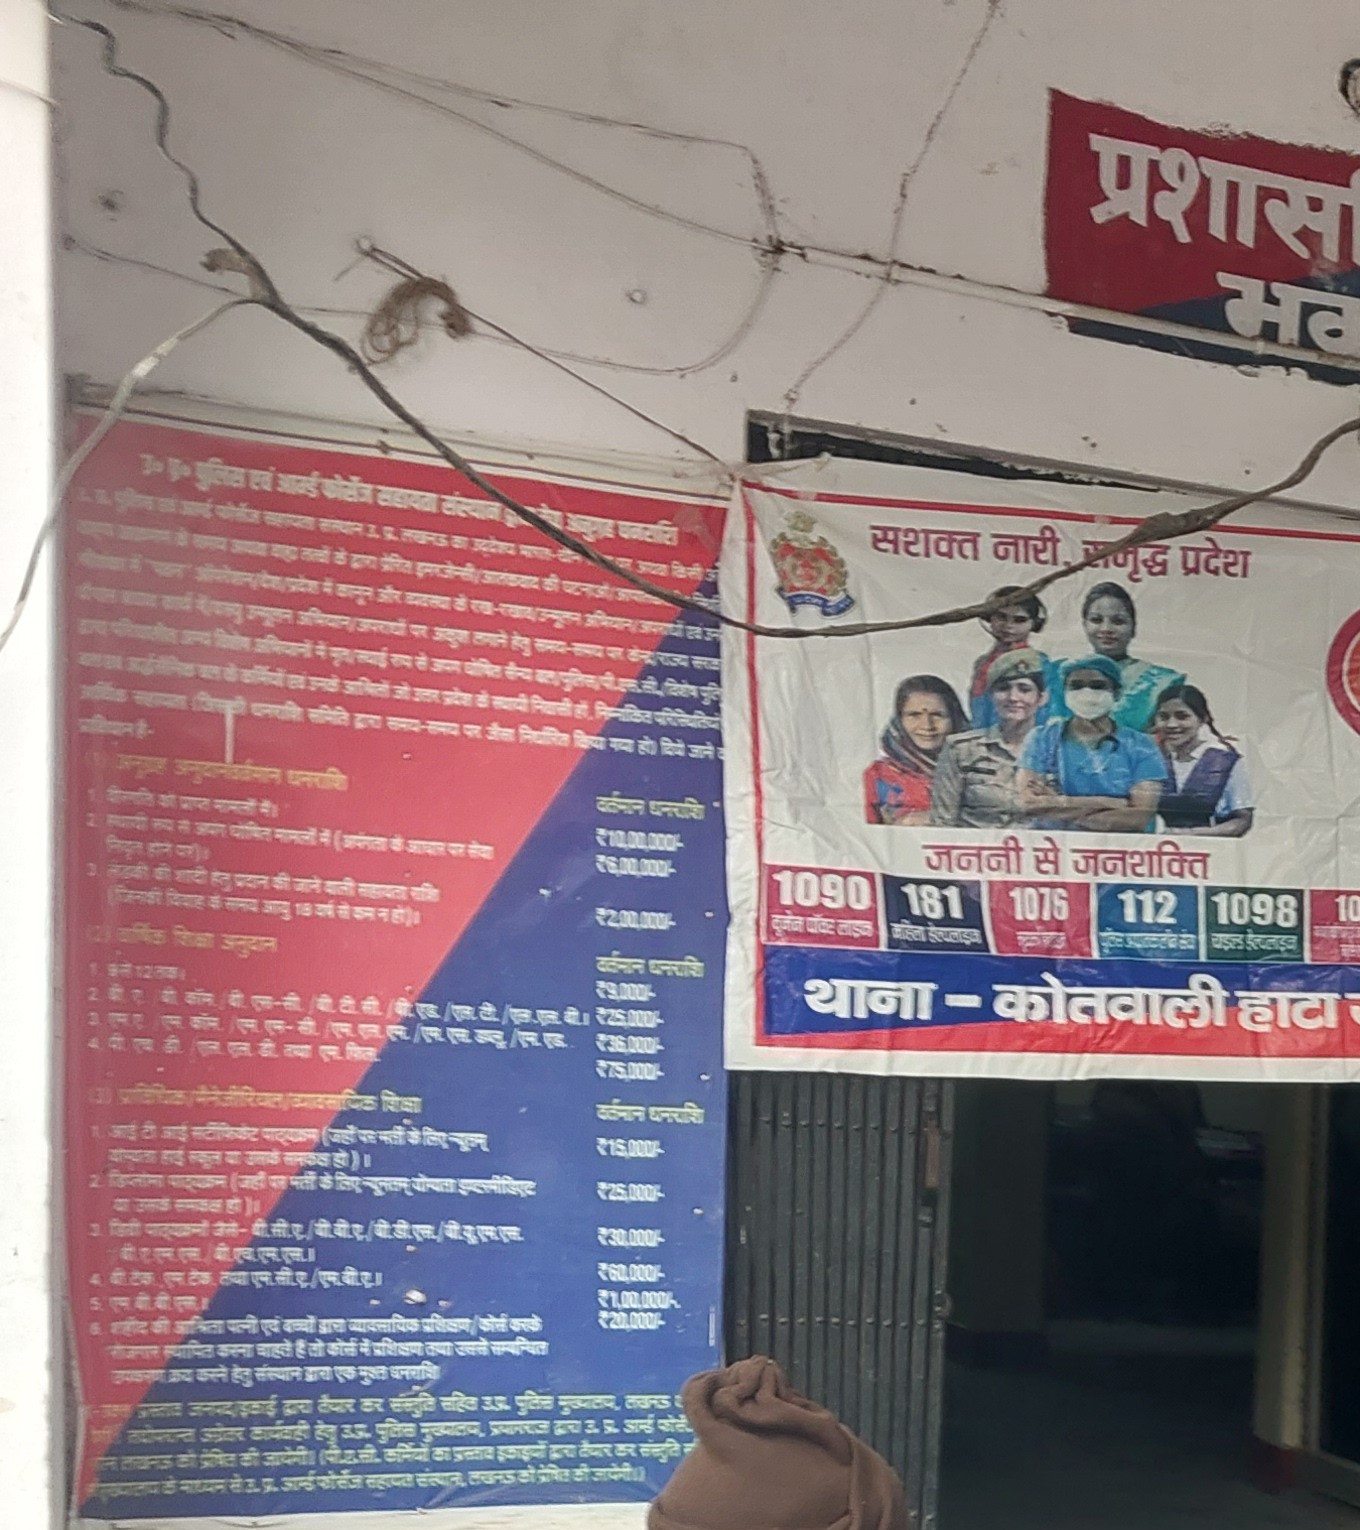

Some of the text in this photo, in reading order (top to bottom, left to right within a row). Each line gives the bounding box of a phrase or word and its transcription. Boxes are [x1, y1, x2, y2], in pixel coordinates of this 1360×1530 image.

[870, 524, 981, 562] सशक्त
[1180, 536, 1252, 578] प्रदेश
[921, 836, 1211, 880] जननी से जनशक्ति
[772, 869, 872, 912] 1090
[900, 882, 966, 920] 181
[1008, 885, 1069, 921] 1076
[1118, 888, 1179, 924] 112
[1210, 891, 1298, 928] 1098
[803, 976, 939, 1021] थाना
[991, 971, 1231, 1029] कोतवाली
[1234, 988, 1339, 1034] हाटा
